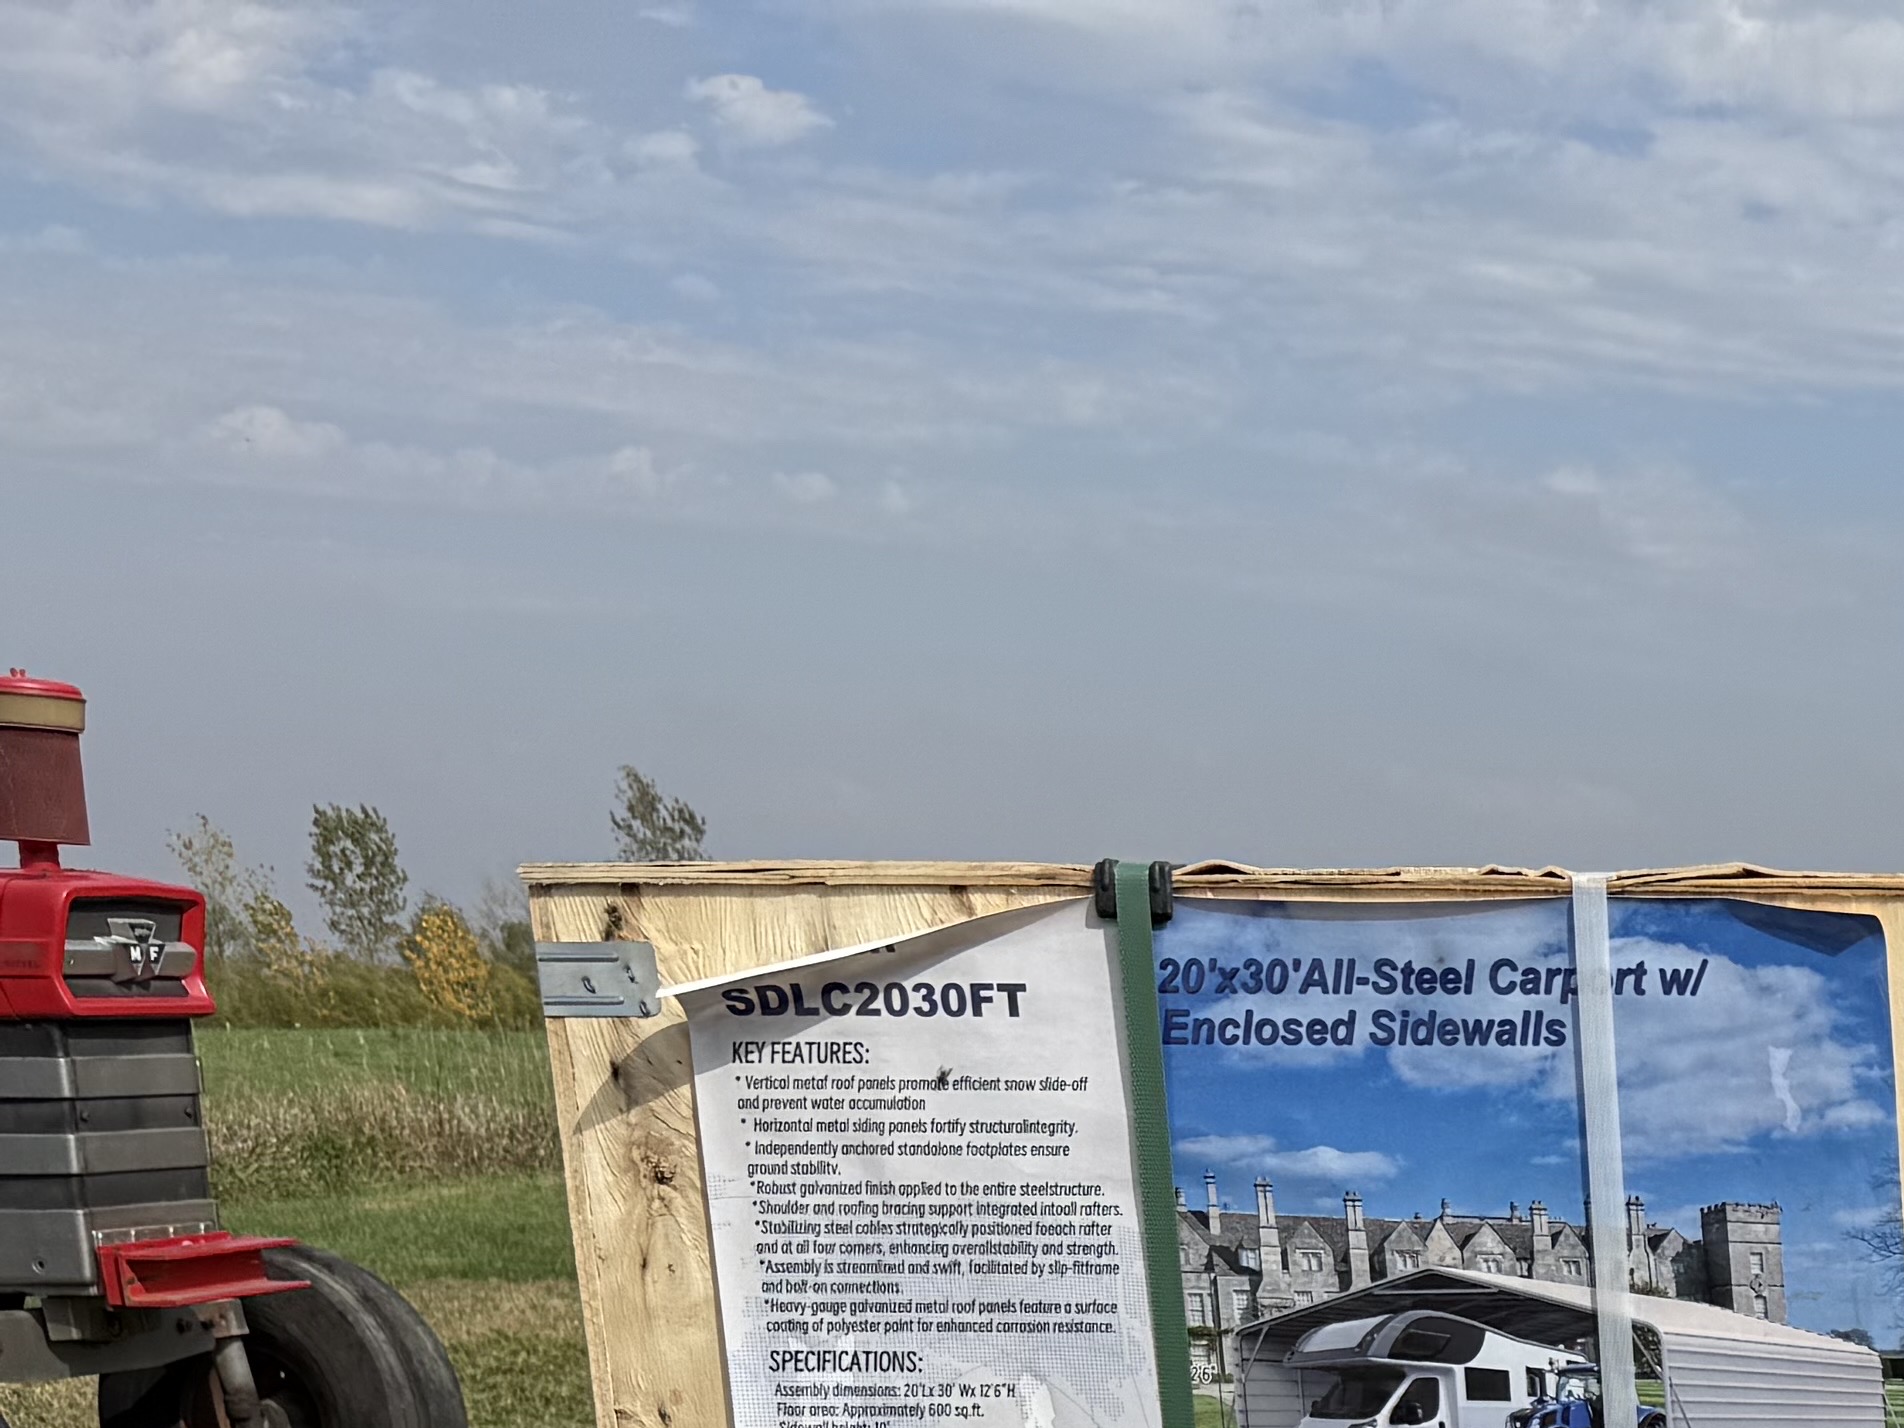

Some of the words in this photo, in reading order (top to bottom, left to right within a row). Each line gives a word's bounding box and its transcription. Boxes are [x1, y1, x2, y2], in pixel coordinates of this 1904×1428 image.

[1489, 957, 1648, 1004] Carprt
[1659, 958, 1709, 996] w/
[721, 982, 1027, 1019] SDLC2030FT
[1161, 1010, 1356, 1047] Enclosed
[1369, 1010, 1567, 1047] Sidewalls
[732, 1041, 767, 1064] KEY
[771, 1041, 870, 1064] FEATURES:
[745, 1075, 790, 1091] Vertical
[831, 1075, 855, 1091] roof
[858, 1075, 896, 1093] panels
[952, 1076, 1001, 1092] efficient
[1004, 1079, 1036, 1092] snow
[768, 1350, 924, 1374] SPECIFICATIONS:
[775, 1383, 830, 1399] Assembly
[832, 1383, 901, 1398] dimensions:
[777, 1402, 805, 1417] Floor
[809, 1404, 839, 1417] area:
[842, 1402, 925, 1419] Approximately
[928, 1403, 951, 1417] 600
